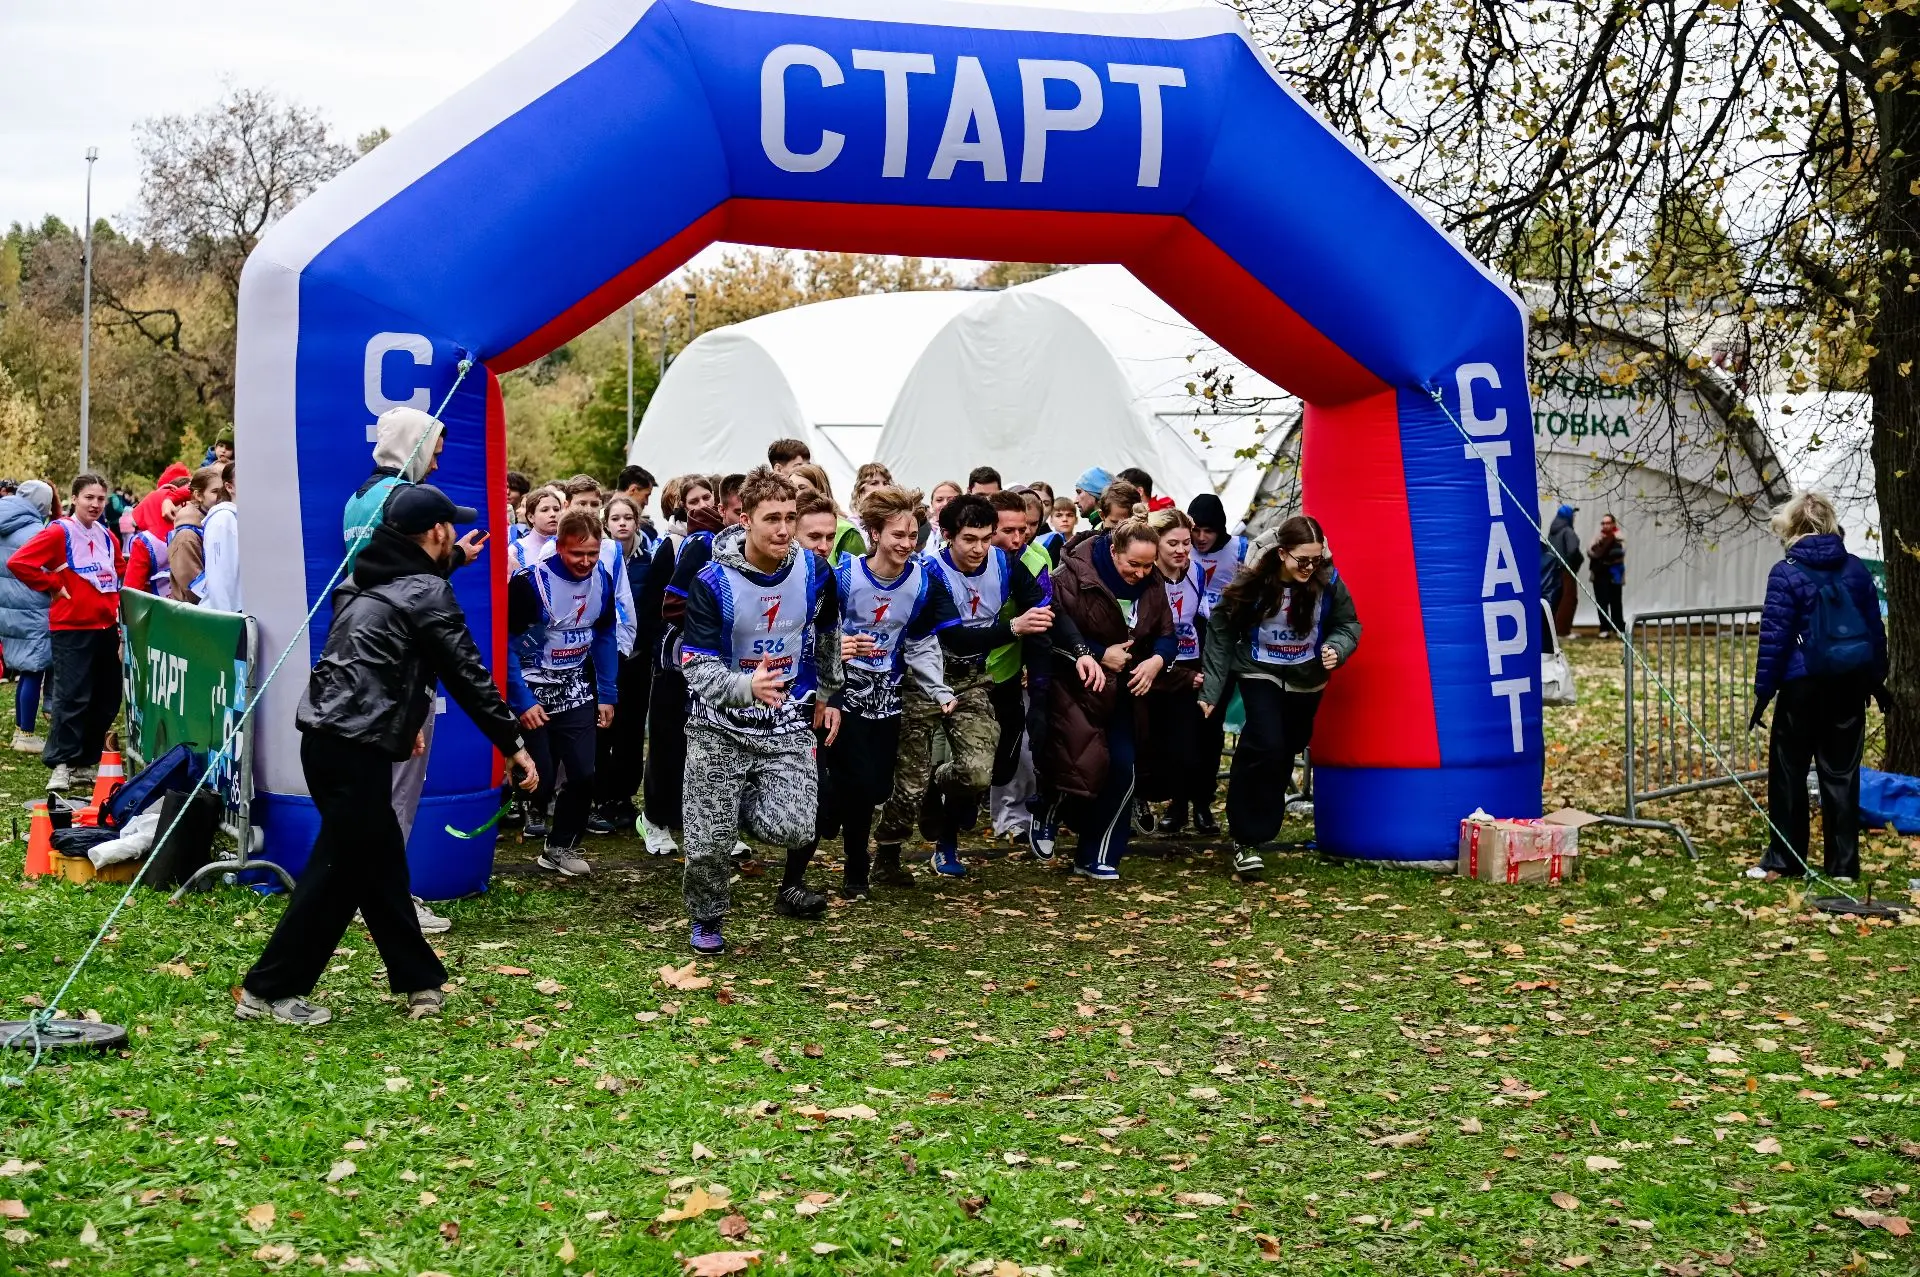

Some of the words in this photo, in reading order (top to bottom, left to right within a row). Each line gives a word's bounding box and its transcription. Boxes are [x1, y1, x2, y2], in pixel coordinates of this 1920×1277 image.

[761, 44, 1186, 187] СТАРТ
[1455, 362, 1531, 753] СТАРТ
[753, 638, 784, 654] 526
